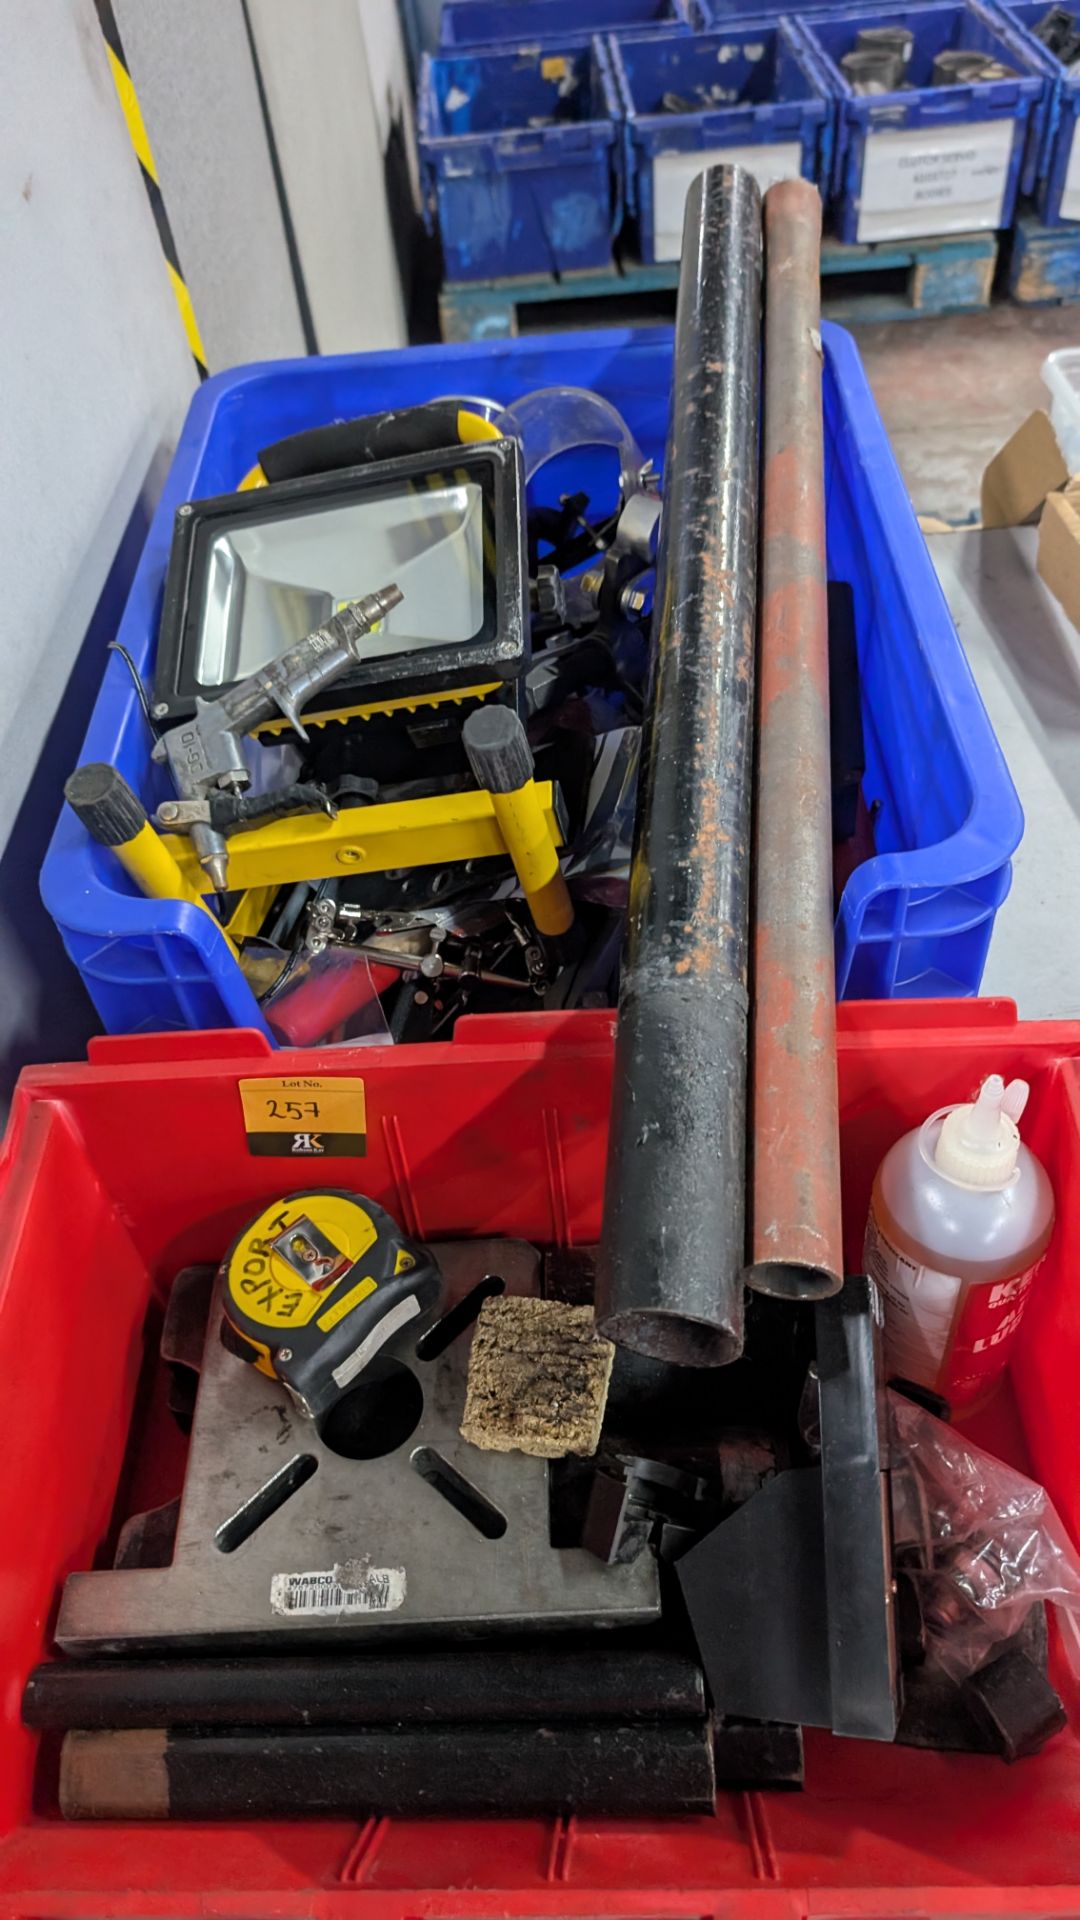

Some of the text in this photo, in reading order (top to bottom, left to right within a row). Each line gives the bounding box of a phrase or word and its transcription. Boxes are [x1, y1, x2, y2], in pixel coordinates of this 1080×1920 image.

[281, 1080, 323, 1088] Lot No.
[266, 1099, 320, 1120] 257
[240, 1210, 303, 1318] EXPORT
[289, 1576, 333, 1586] WABCO
